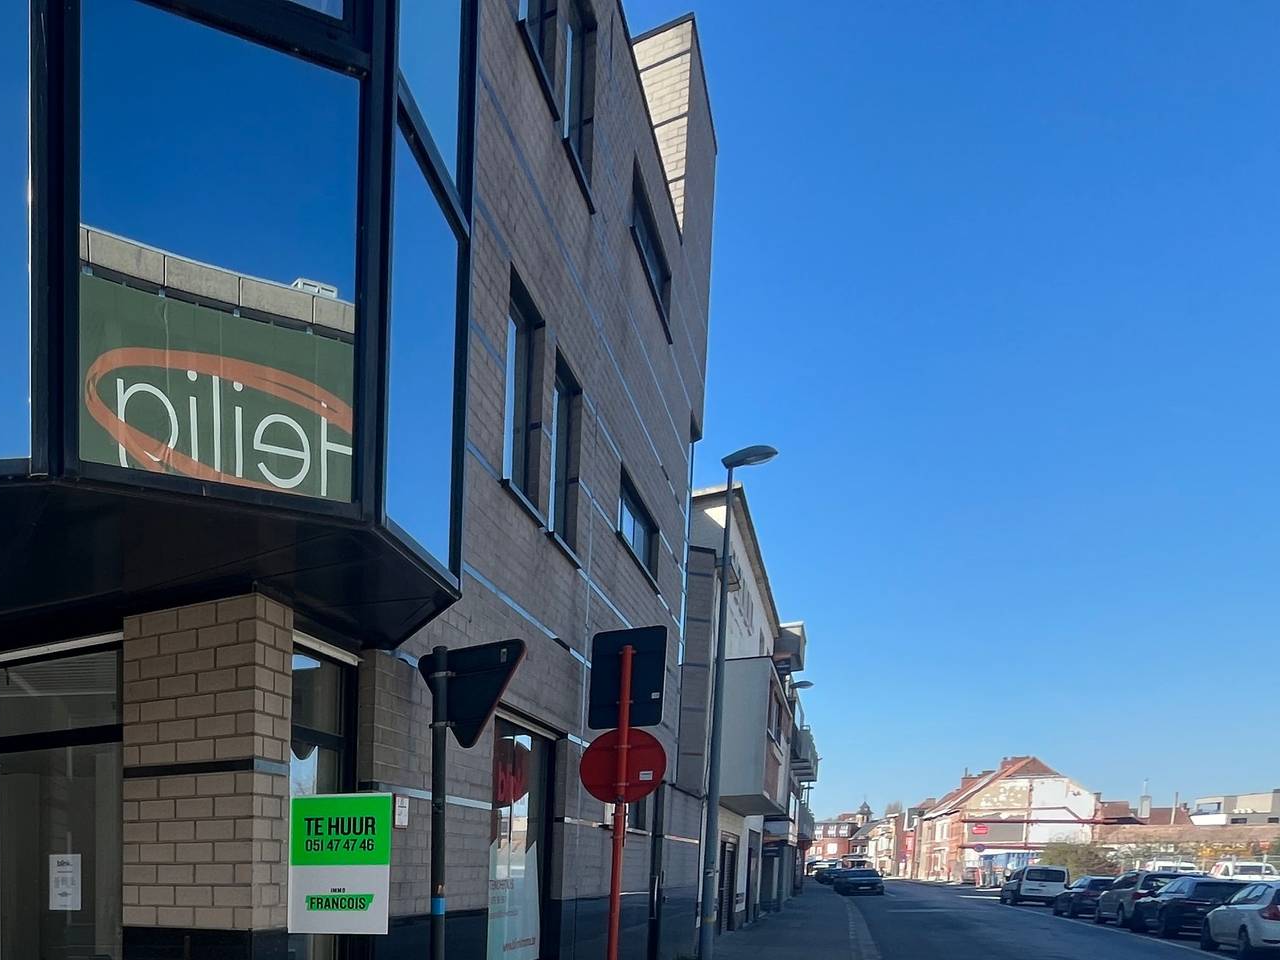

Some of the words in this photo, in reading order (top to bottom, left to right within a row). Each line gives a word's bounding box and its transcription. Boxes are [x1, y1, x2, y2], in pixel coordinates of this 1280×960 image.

[304, 817, 324, 836] TE
[328, 816, 376, 836] HUUR
[305, 839, 324, 852] 051
[327, 839, 341, 851] 47
[343, 839, 357, 851] 47
[359, 839, 375, 851] 46
[309, 897, 366, 910] FRANCOIS
